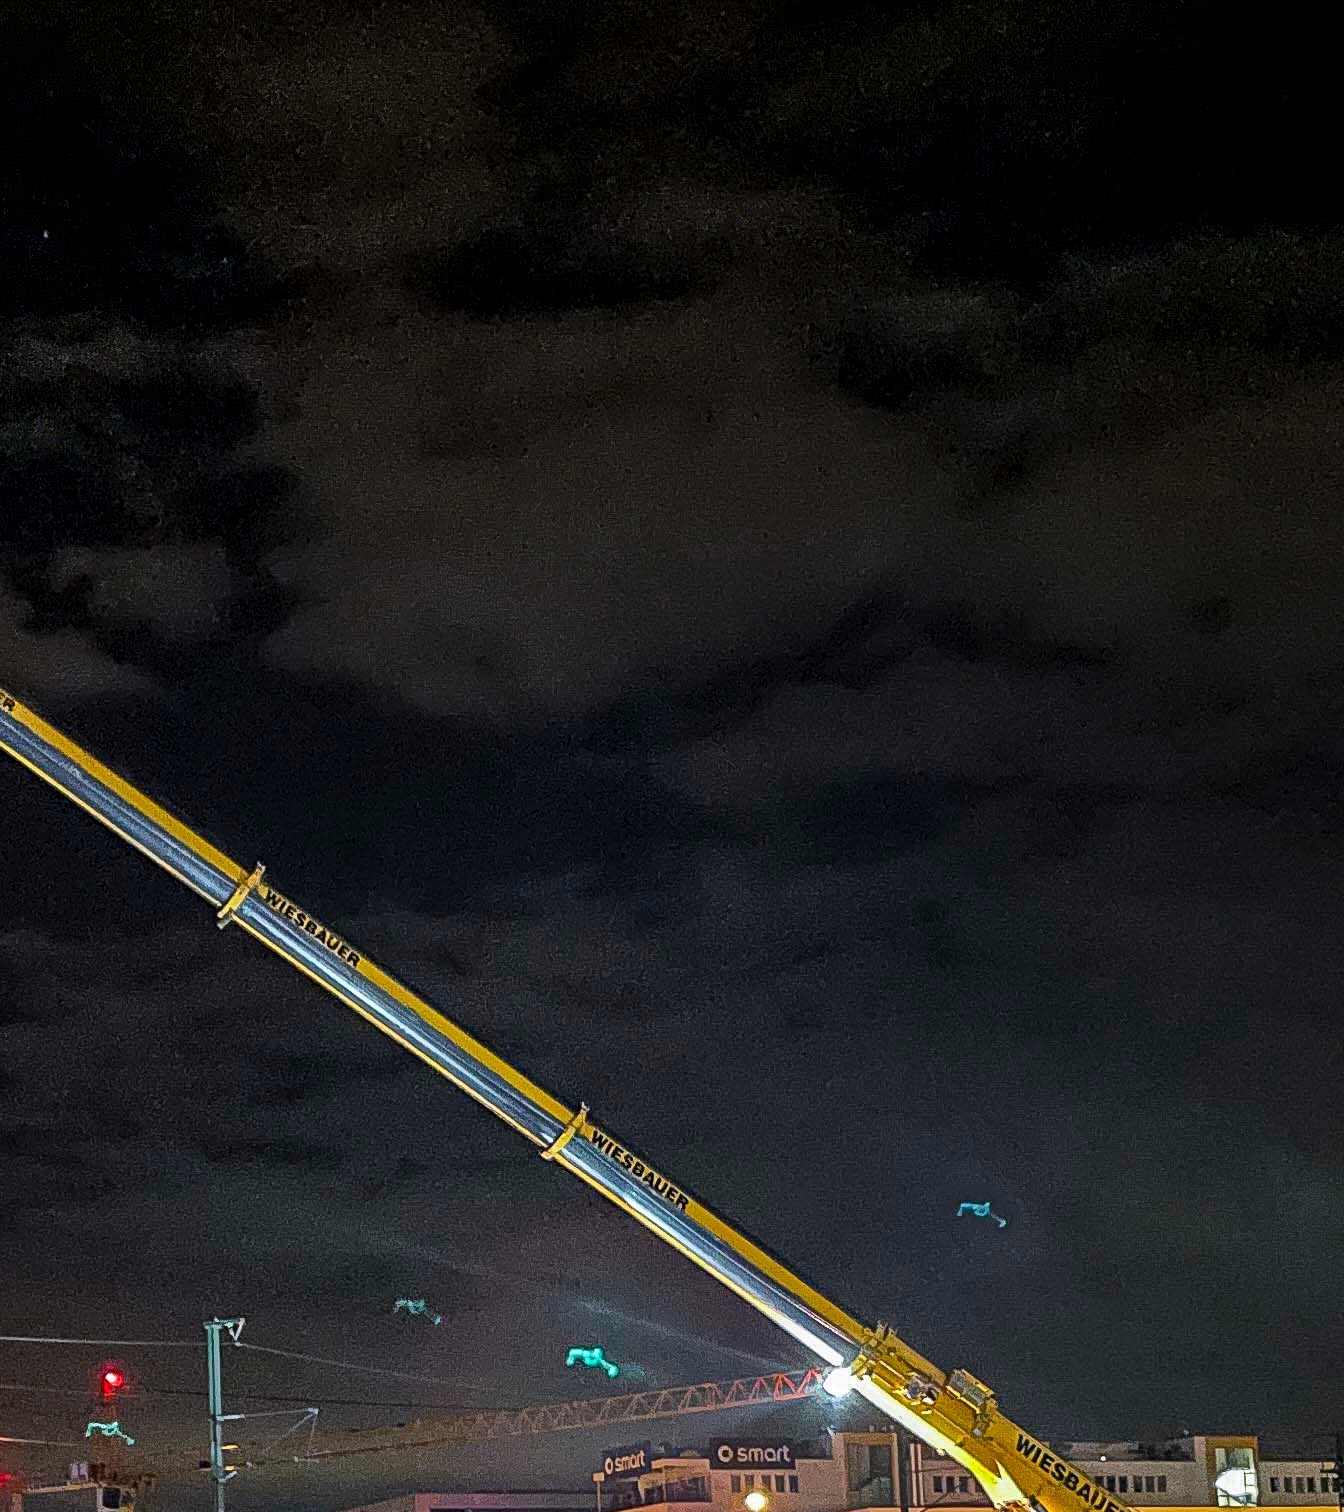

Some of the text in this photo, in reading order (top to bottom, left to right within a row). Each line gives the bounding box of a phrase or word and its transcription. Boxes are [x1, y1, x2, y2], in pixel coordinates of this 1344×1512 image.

[265, 888, 361, 967] WIESBAUER
[591, 1130, 689, 1211] WIESBAUER
[614, 1449, 647, 1473] smart
[736, 1444, 792, 1463] smart
